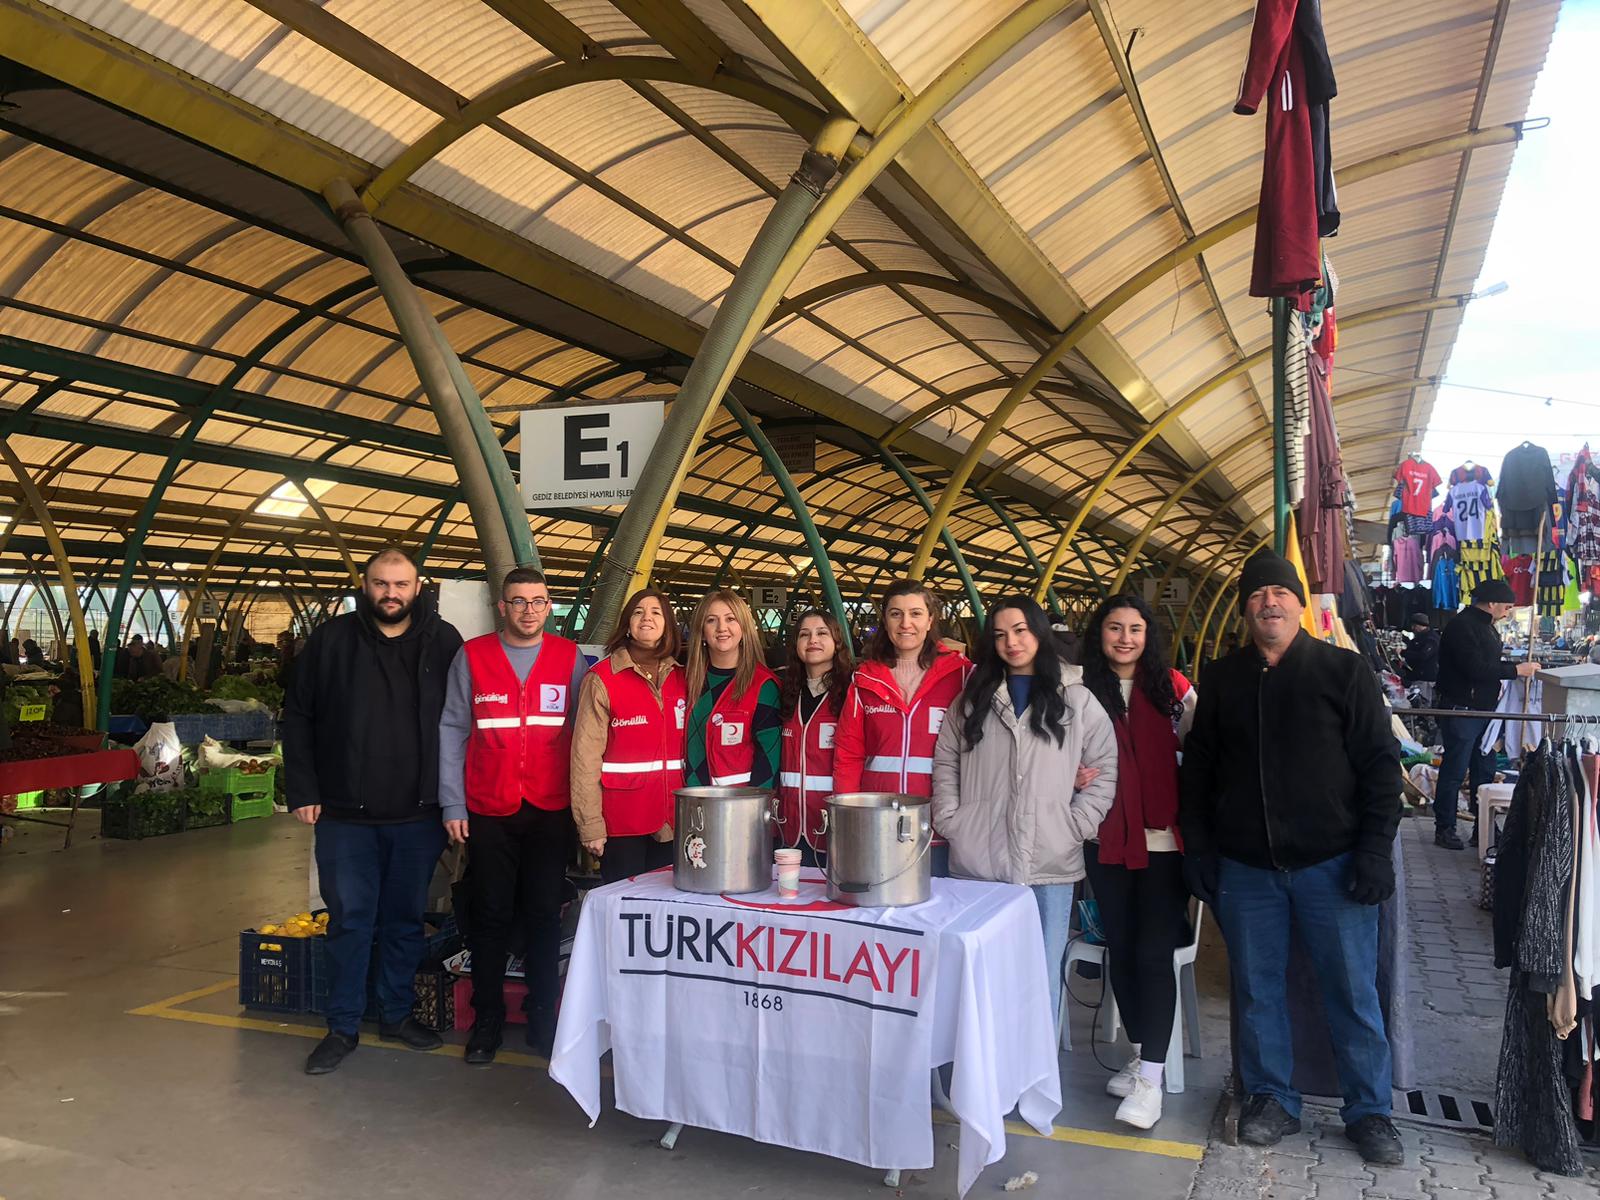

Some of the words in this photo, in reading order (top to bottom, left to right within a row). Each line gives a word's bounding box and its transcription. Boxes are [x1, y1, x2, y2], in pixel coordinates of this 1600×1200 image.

[563, 412, 629, 481] E1
[532, 491, 552, 501] GEDİZ
[553, 489, 589, 500] BELEDİYESİ
[589, 489, 615, 499] HAYIRLI
[1413, 478, 1423, 496] 7
[1457, 497, 1479, 522] 24
[762, 588, 779, 604] E2
[743, 990, 783, 1012] 1868
